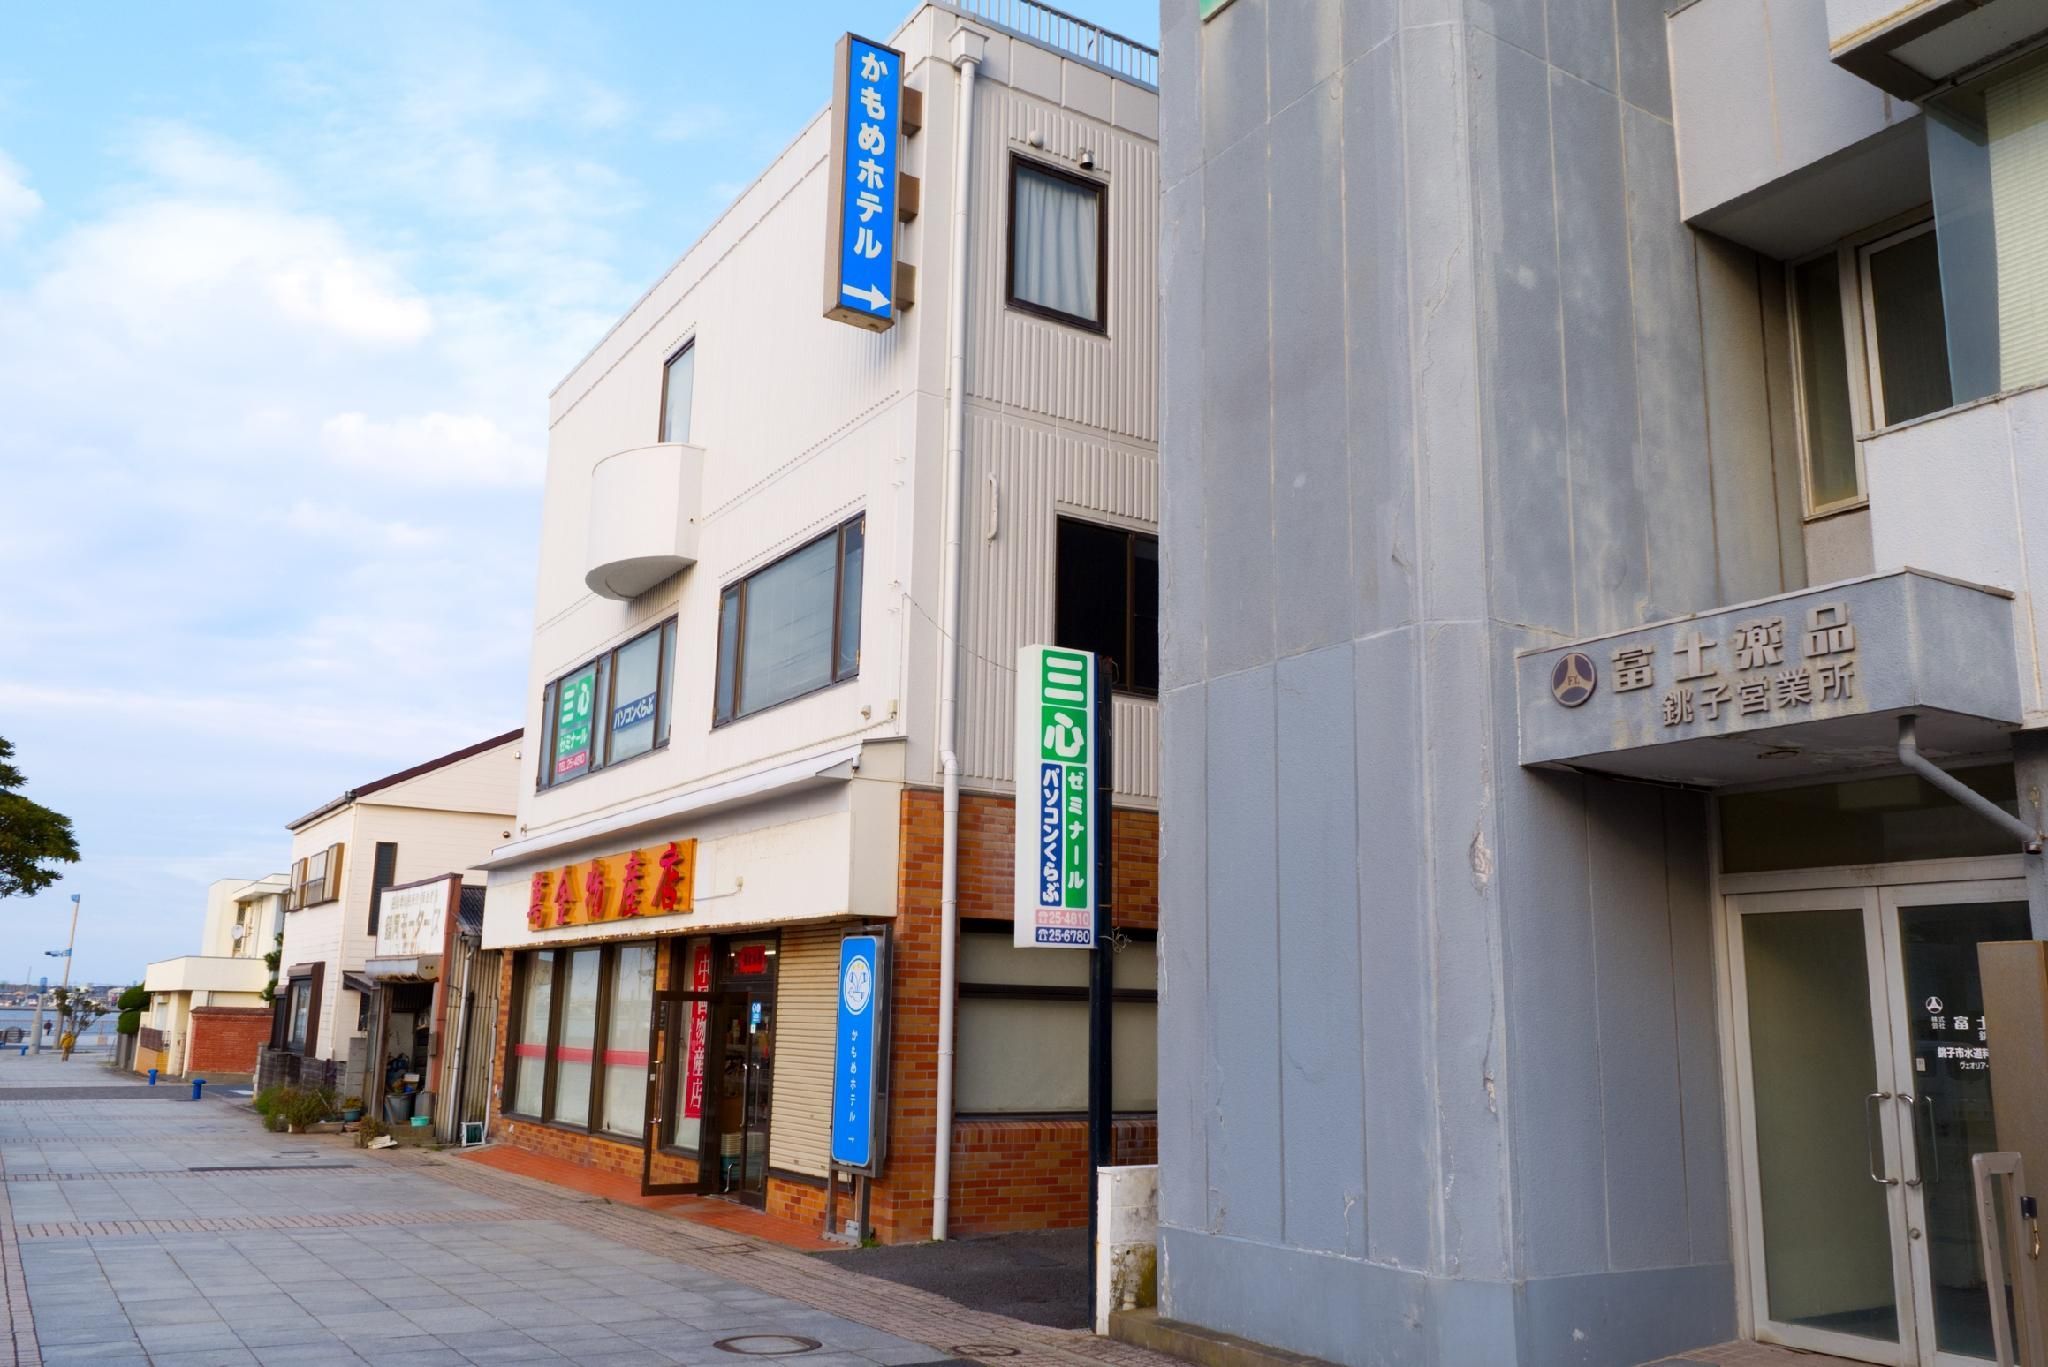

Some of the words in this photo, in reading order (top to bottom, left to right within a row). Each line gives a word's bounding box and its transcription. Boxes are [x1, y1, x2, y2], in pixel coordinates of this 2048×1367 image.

[853, 52, 888, 260] かもめホテル
[1611, 602, 1856, 693] 富士薬品
[1663, 660, 1855, 727] 銚子営業所
[560, 728, 587, 752] ゼミナール
[562, 684, 589, 723] 三心
[1043, 656, 1085, 757] 三心
[1043, 768, 1060, 903] パソコンくらぶ
[1067, 772, 1085, 889] ゼミナール
[849, 1029, 858, 1122] かもめホテル
